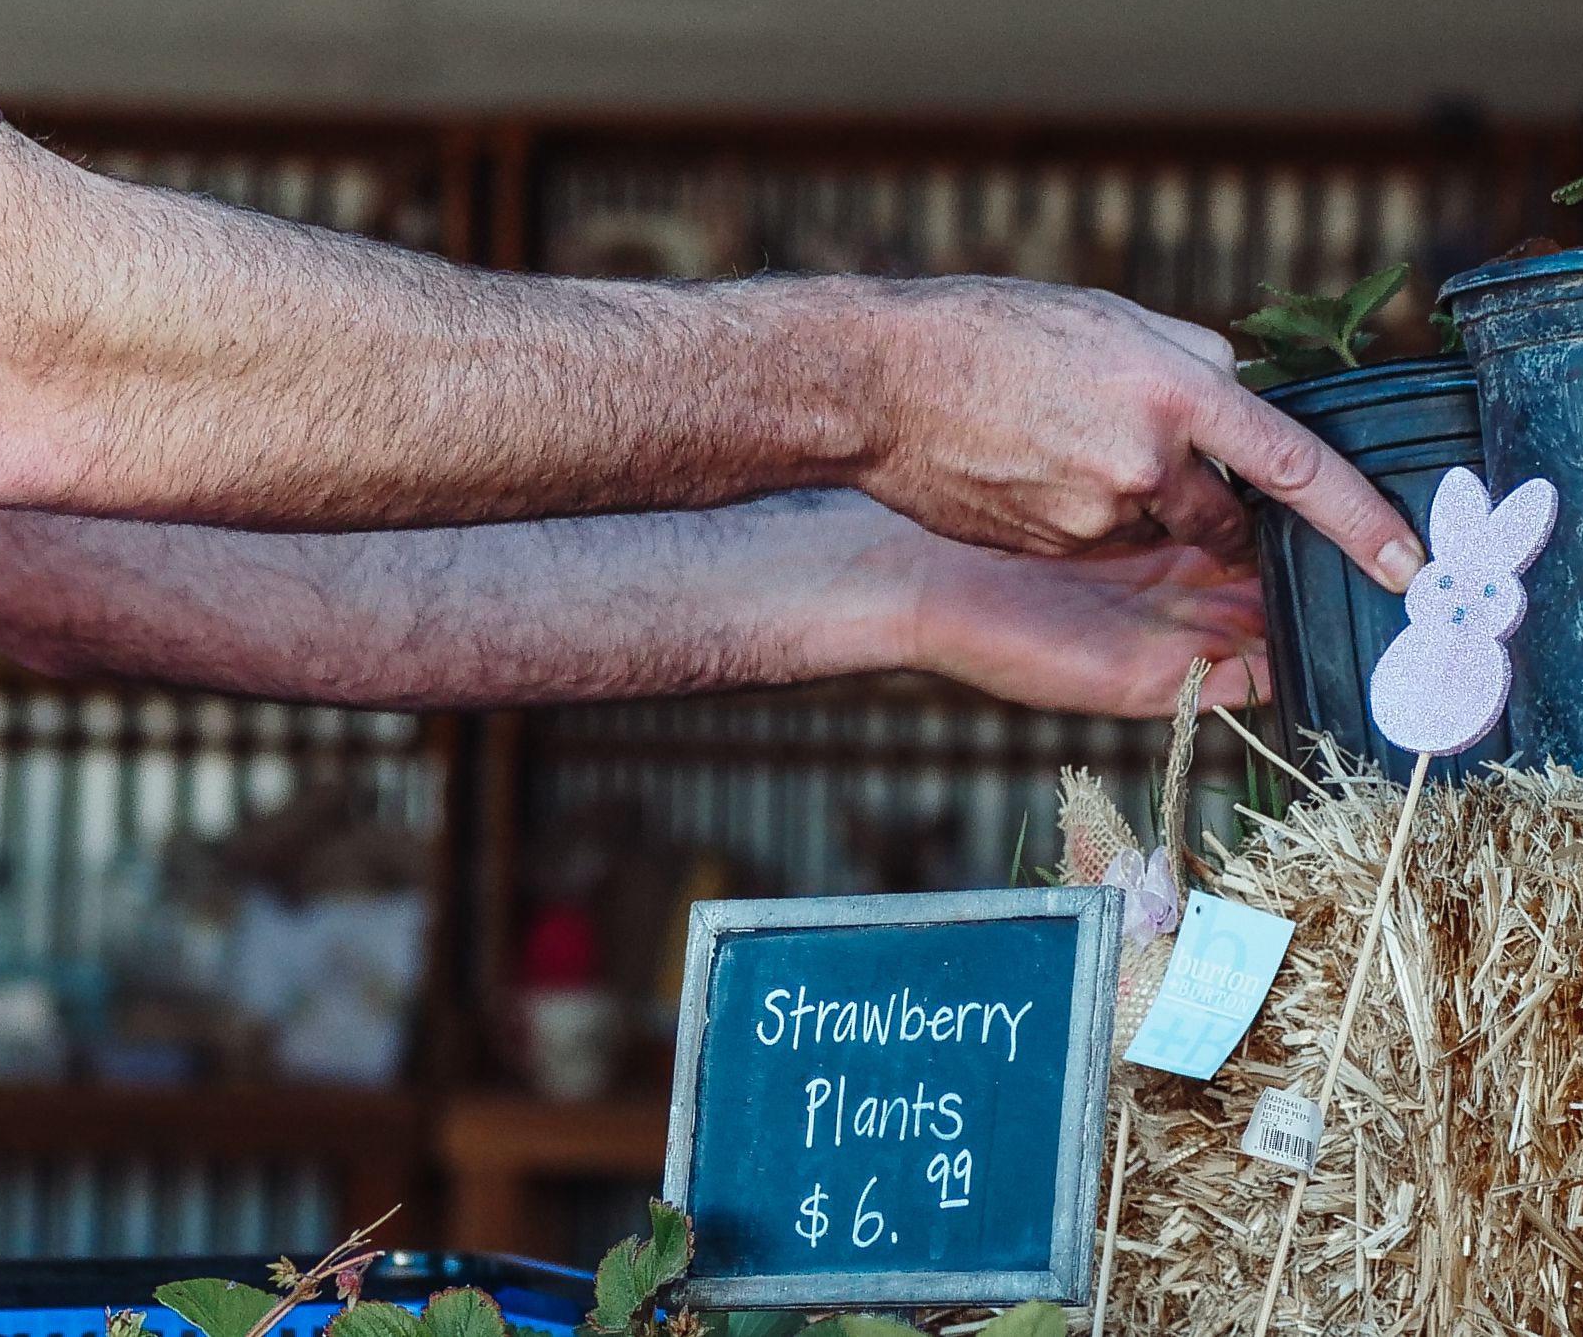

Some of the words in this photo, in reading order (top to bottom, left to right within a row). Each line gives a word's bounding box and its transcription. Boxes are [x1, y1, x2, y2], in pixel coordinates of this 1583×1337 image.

[1167, 976, 1253, 1012] +BURTON
[1174, 946, 1260, 996] burton
[756, 985, 1033, 1062] Strawberry
[805, 1075, 964, 1148] Plants
